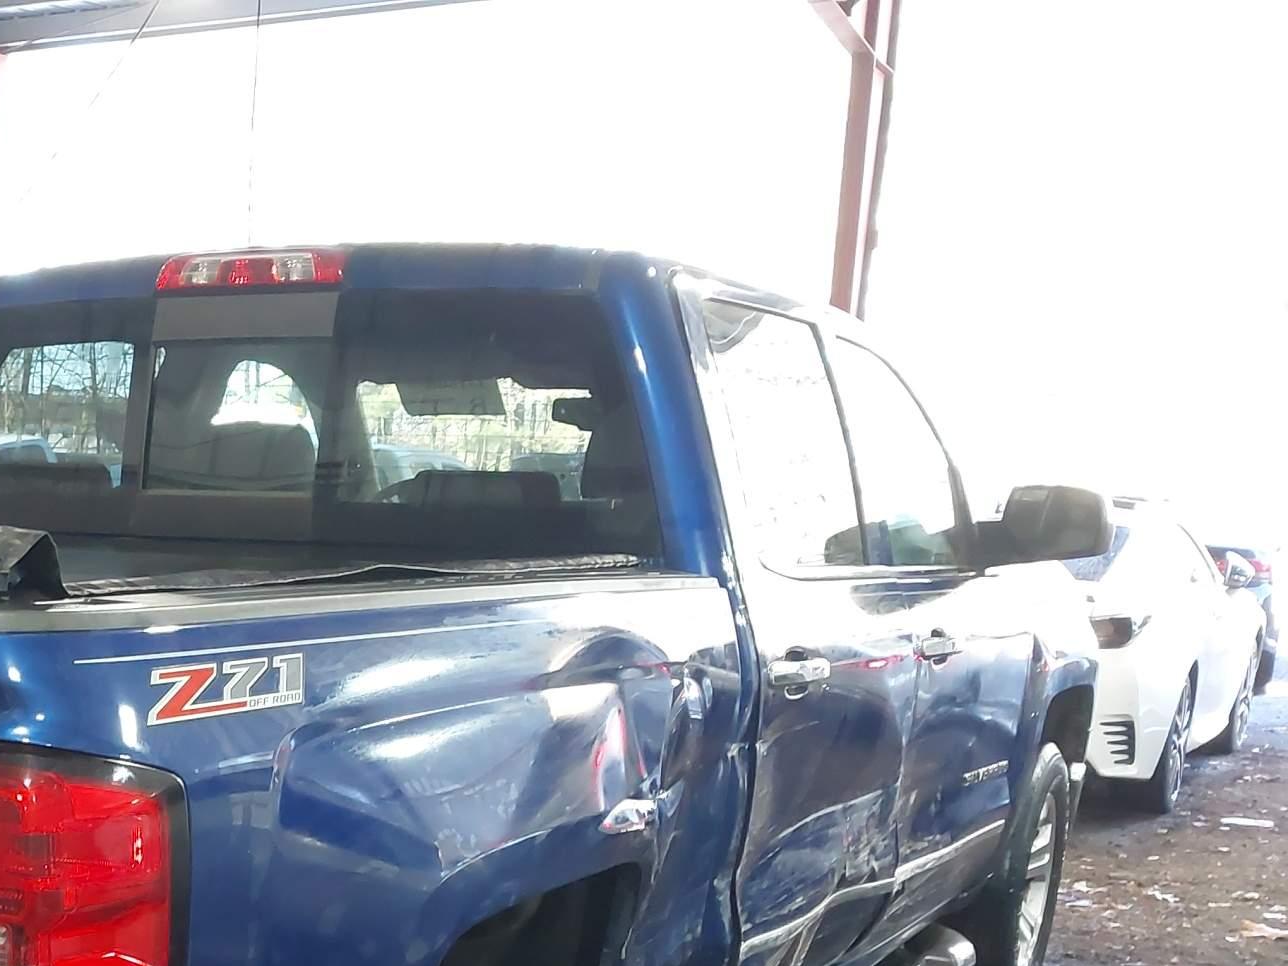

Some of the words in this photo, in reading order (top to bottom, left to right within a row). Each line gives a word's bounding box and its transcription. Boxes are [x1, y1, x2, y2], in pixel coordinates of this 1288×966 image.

[147, 653, 304, 727] Z71
[249, 697, 269, 708] OFF
[272, 692, 301, 705] ROAD
